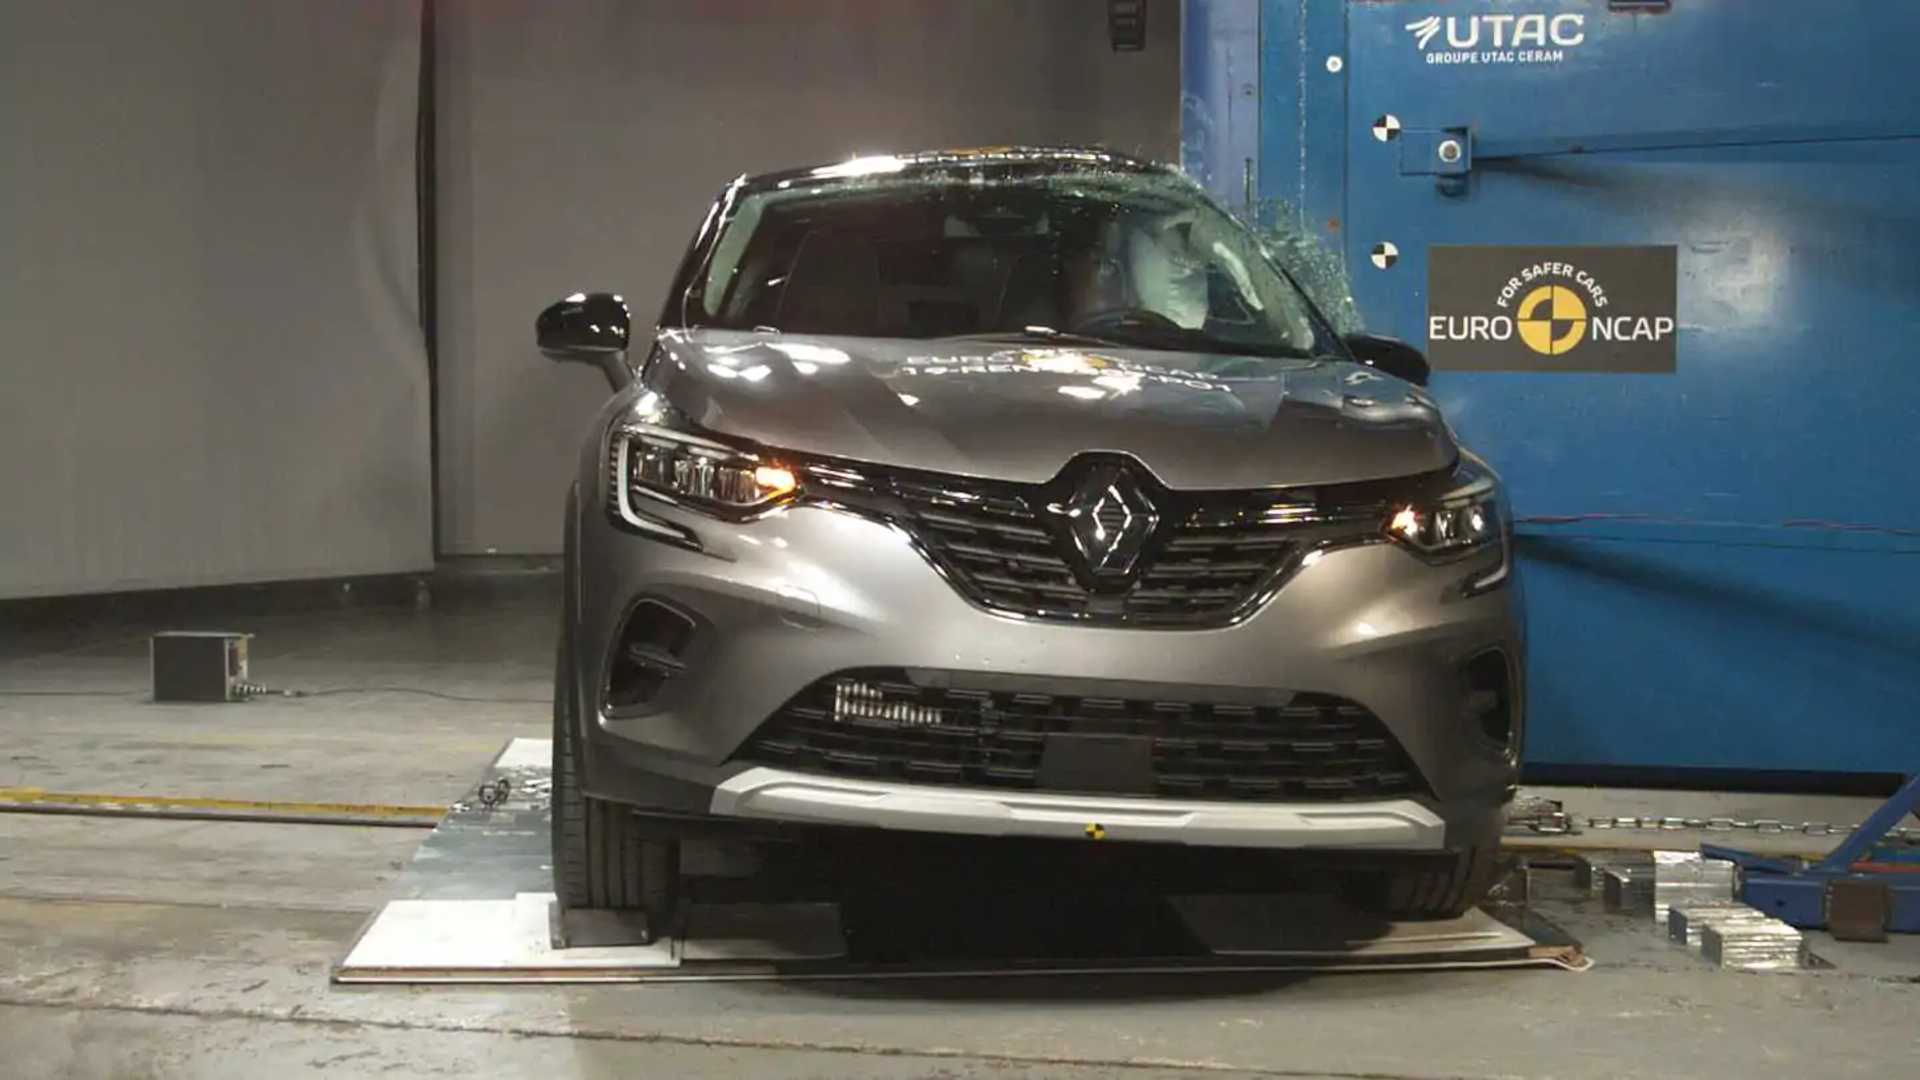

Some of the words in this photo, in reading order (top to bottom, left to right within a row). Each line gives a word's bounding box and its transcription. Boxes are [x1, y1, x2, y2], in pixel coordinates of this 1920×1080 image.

[1446, 13, 1585, 48] UTAC
[1426, 51, 1478, 64] GROUPE
[1481, 51, 1514, 63] UTAC
[1518, 50, 1564, 62] CERAM
[1497, 277, 1523, 308] FOR
[1521, 262, 1574, 283] SAFER
[1575, 270, 1608, 308] CARS
[1429, 315, 1512, 340] EURO
[1592, 316, 1674, 340] NCAP
